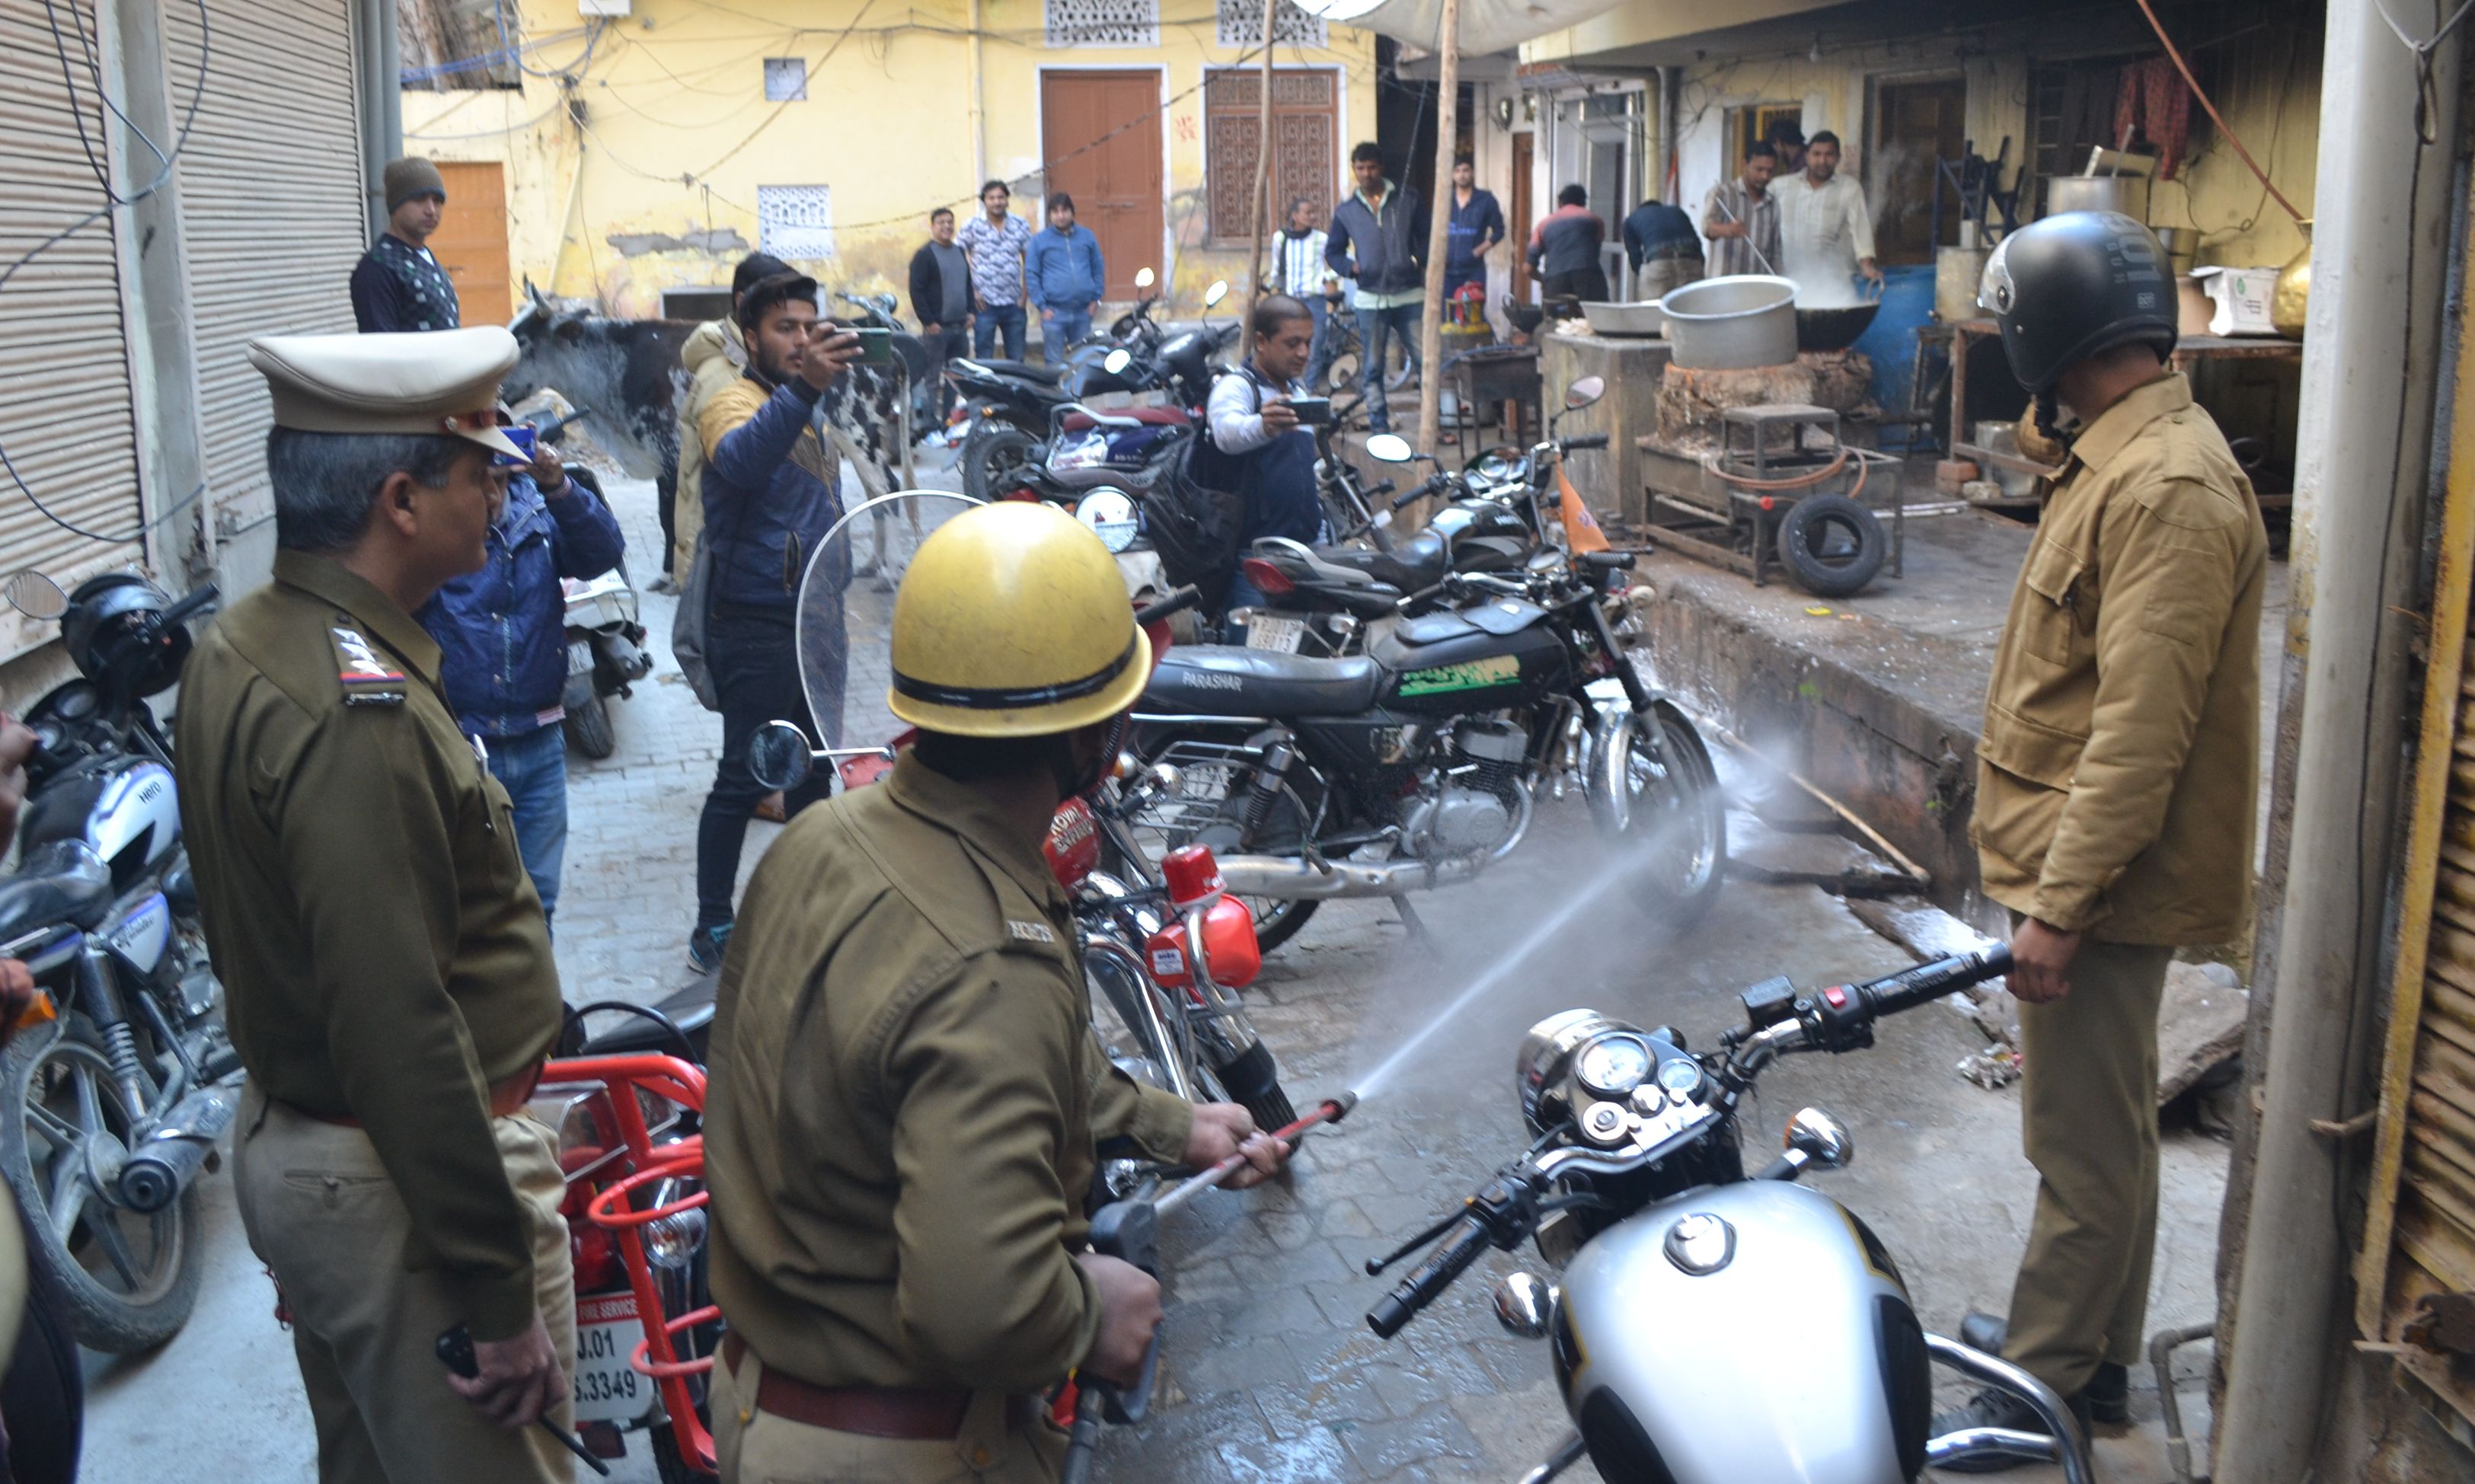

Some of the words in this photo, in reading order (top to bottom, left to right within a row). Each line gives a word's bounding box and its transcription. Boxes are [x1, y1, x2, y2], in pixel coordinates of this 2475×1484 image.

[1182, 670, 1242, 693] PARASHAR
[1049, 805, 1083, 837] ROYAL
[599, 1297, 639, 1320] SERVICE
